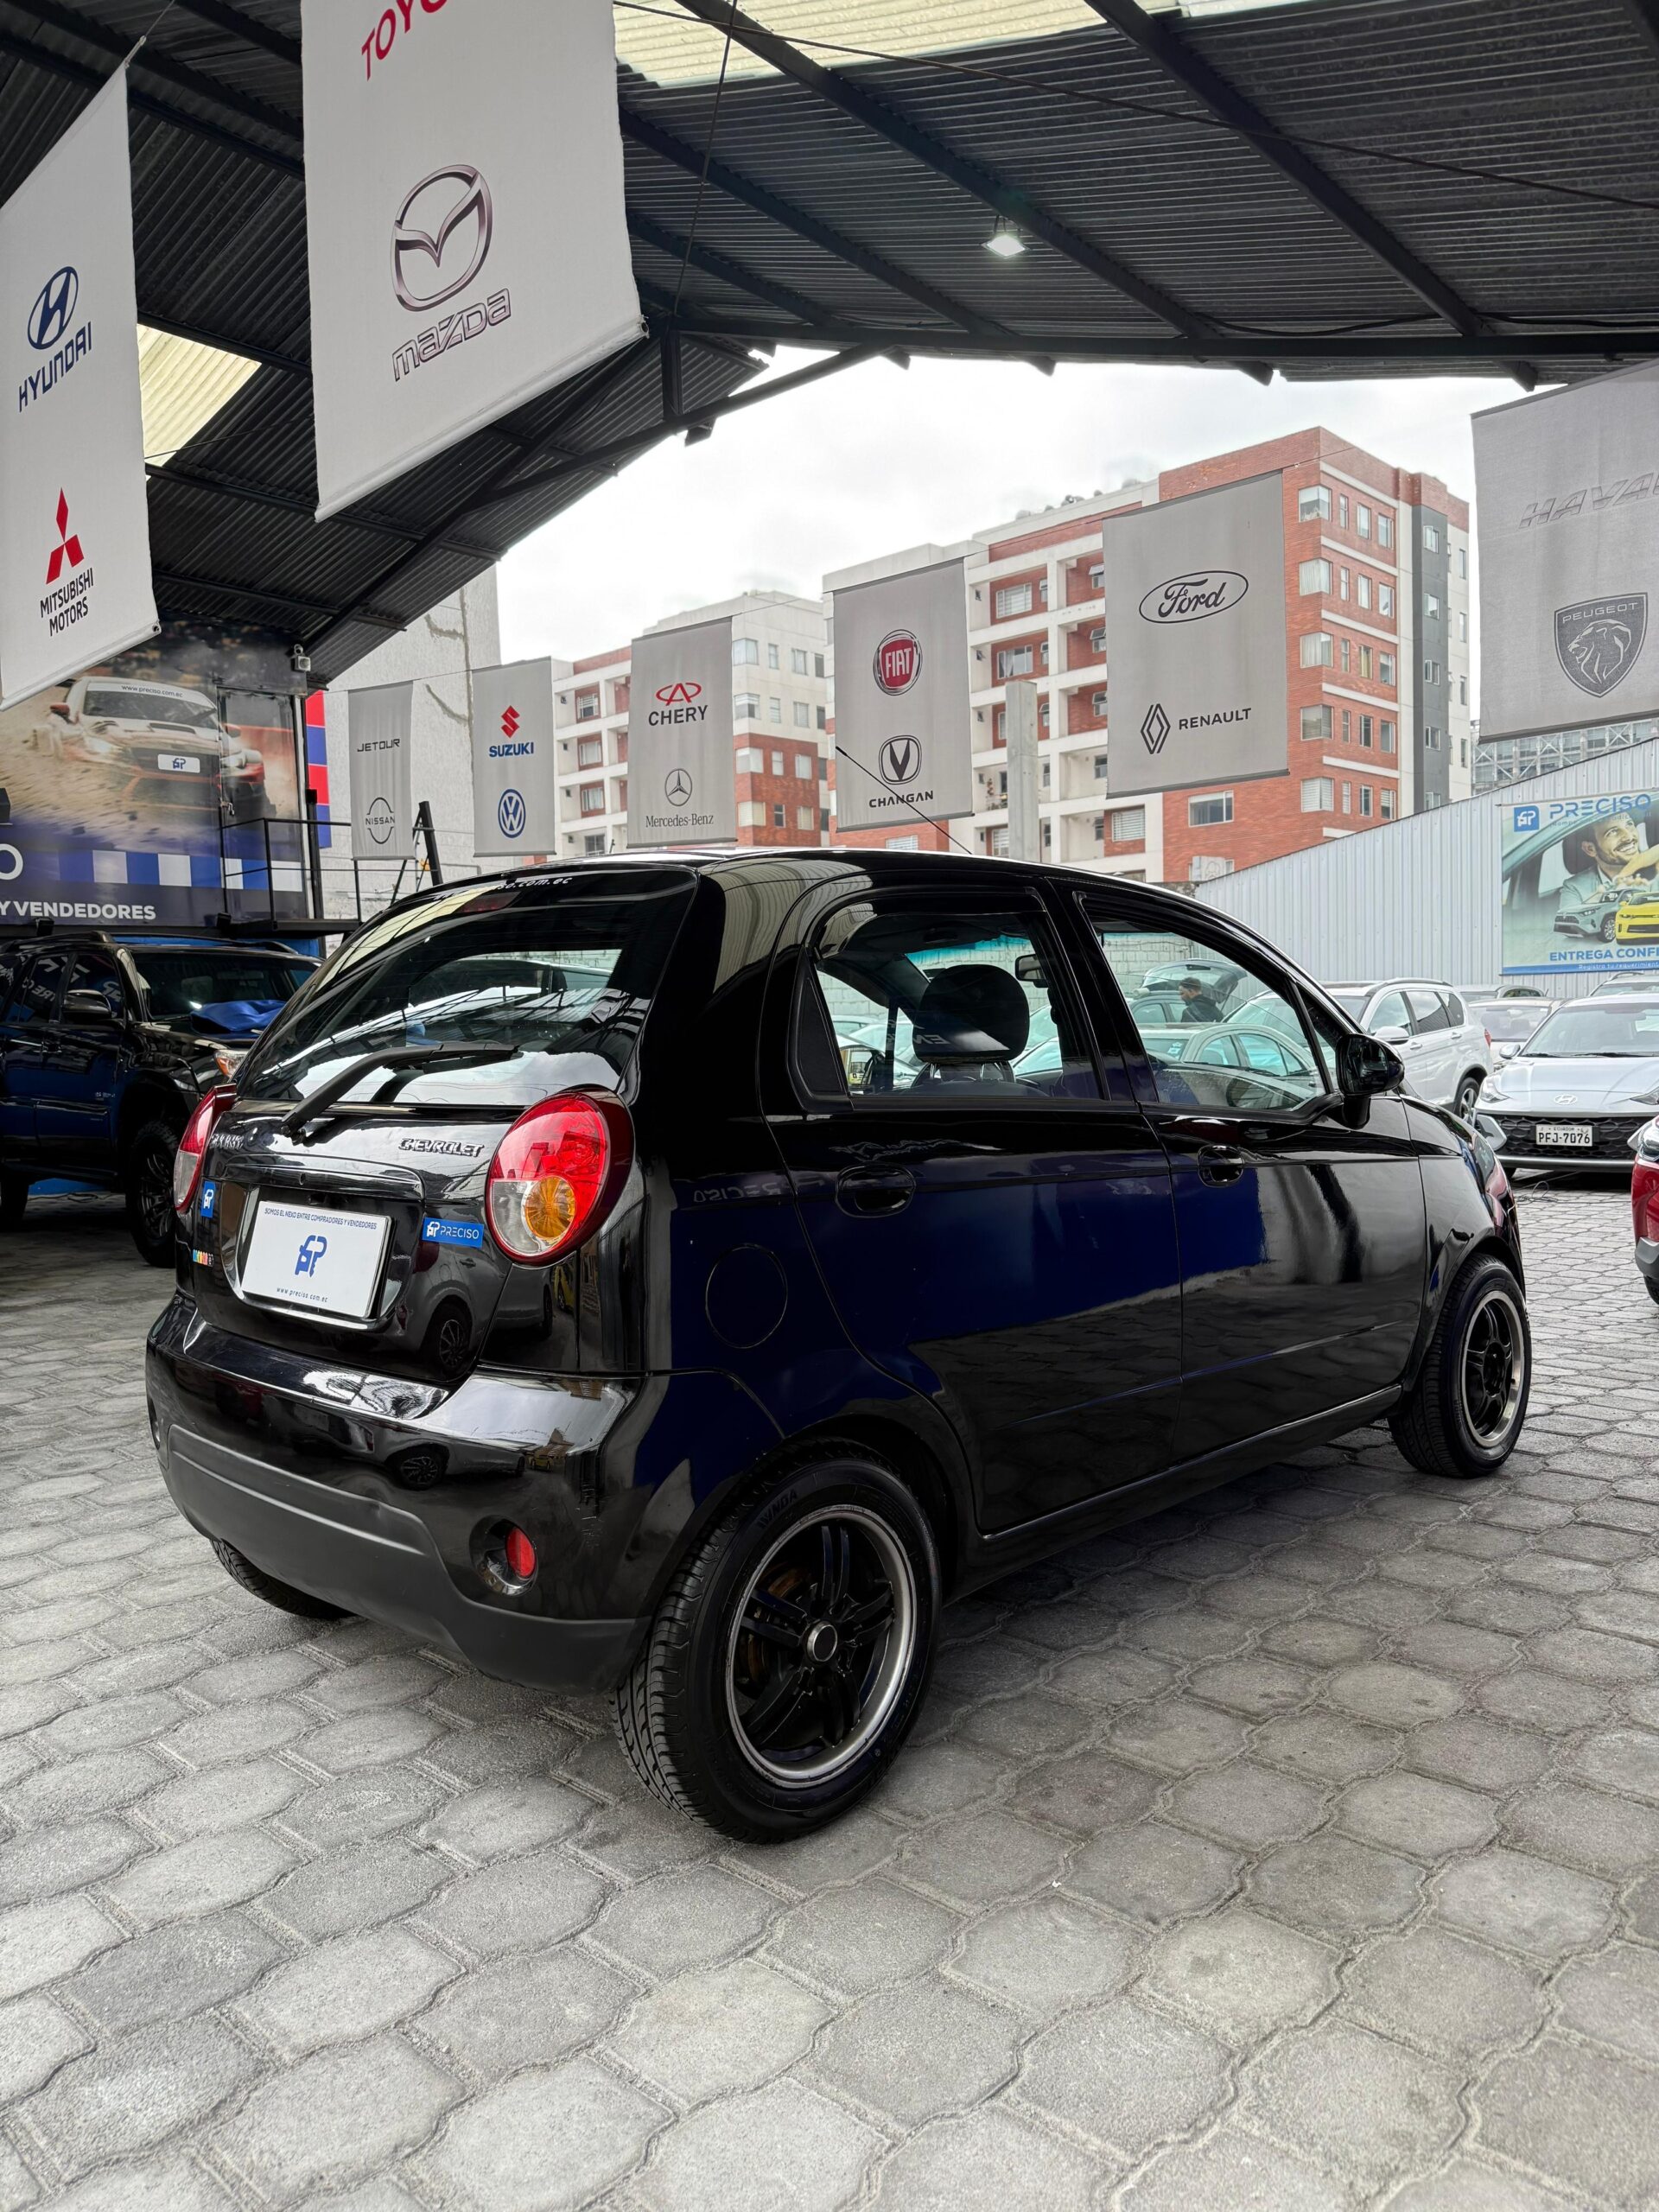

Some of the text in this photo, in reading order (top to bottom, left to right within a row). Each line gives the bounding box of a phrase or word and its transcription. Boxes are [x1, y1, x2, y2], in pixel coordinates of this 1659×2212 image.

[361, 0, 448, 82] TOY
[19, 321, 92, 413] HYUNDAI
[1518, 472, 1659, 529] HAVA
[40, 567, 94, 619] MITSUBISHI
[1158, 578, 1227, 618] Ford
[49, 595, 89, 637] MOTORS
[1562, 602, 1638, 624] PEUGEOT
[885, 647, 912, 679] FIAT
[648, 704, 709, 727] CHERY
[1179, 708, 1252, 730] RENAULT
[357, 738, 401, 753] JETOUR
[488, 741, 535, 758] SUZUKI
[868, 791, 934, 808] CHANGAN
[1549, 793, 1652, 819] PRECISO
[365, 816, 396, 826] NISSAN
[645, 813, 714, 828] Mercedes-Benz
[13, 900, 156, 920] VENDEDORES
[1549, 950, 1613, 961] ENTREGA
[398, 1138, 485, 1158] CHEVROLET
[264, 1207, 279, 1216] SOMOS
[311, 1214, 343, 1225] COMPRADORES
[347, 1219, 378, 1230] VENDEDORES
[440, 1225, 480, 1240] PRECISO
